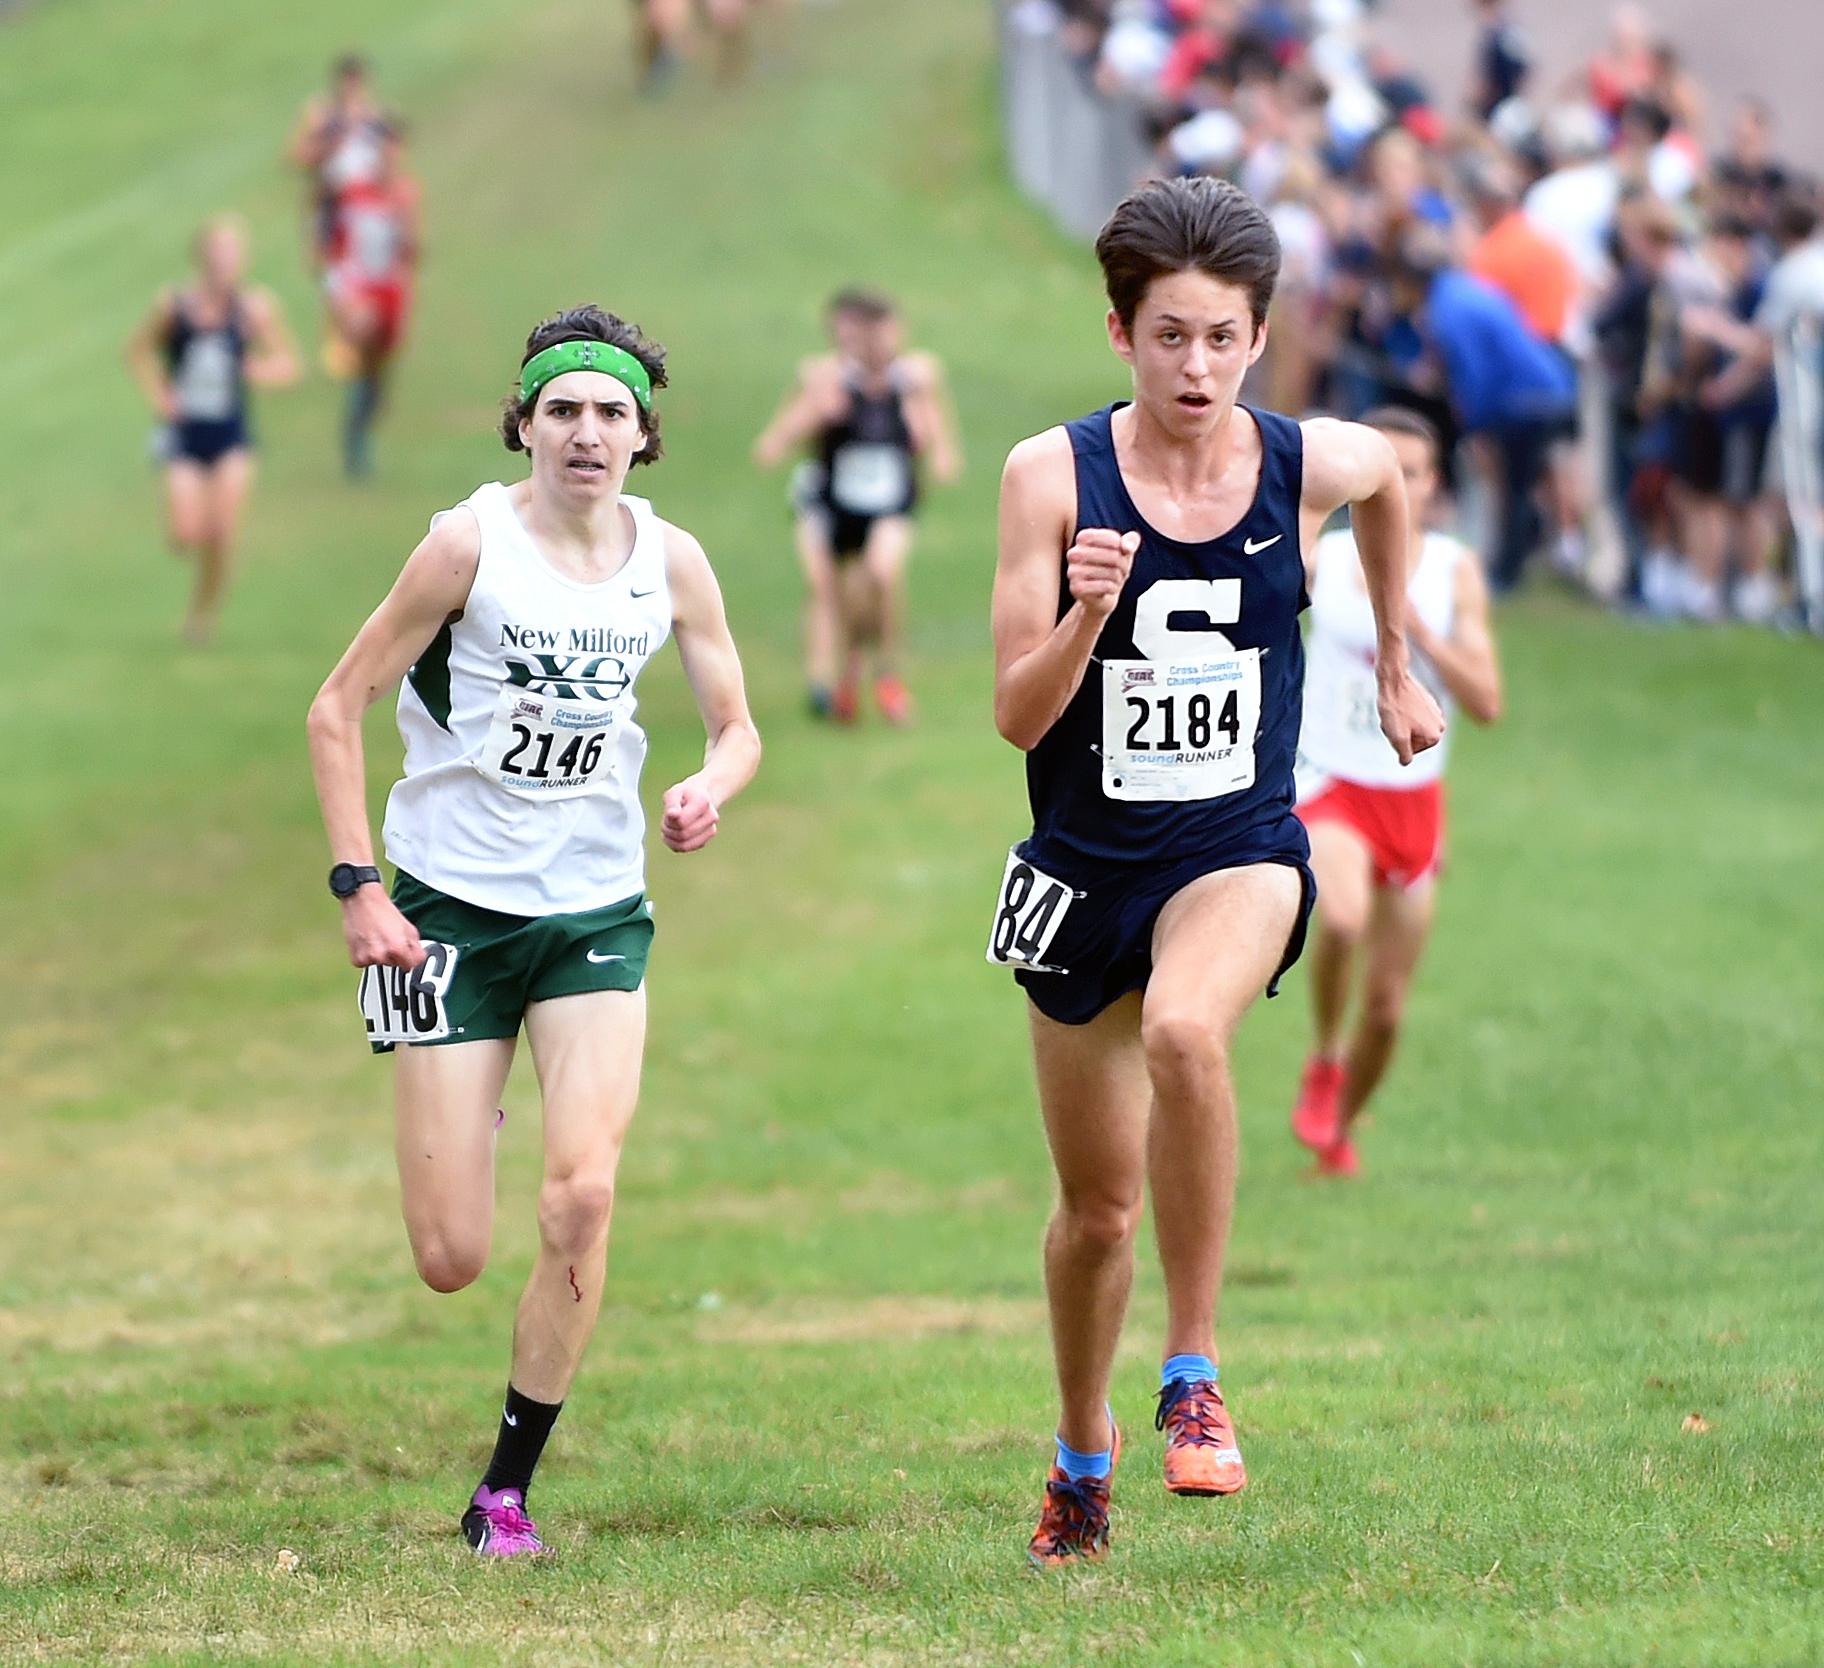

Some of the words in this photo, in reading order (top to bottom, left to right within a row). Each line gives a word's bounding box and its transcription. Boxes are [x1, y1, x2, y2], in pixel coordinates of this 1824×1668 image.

[500, 624, 560, 649] New
[568, 628, 648, 657] Milford
[1169, 665, 1199, 676] Cross
[1202, 661, 1240, 674] Country
[527, 654, 625, 701] XC
[1166, 672, 1243, 687] Championships
[555, 708, 582, 721] Cross
[1126, 690, 1240, 751] 2184
[550, 717, 613, 730] Championships
[499, 723, 607, 778] 2146
[1130, 748, 1233, 764] soundRUNNER
[501, 775, 588, 789] soundRUNNER
[994, 862, 1065, 962] 84
